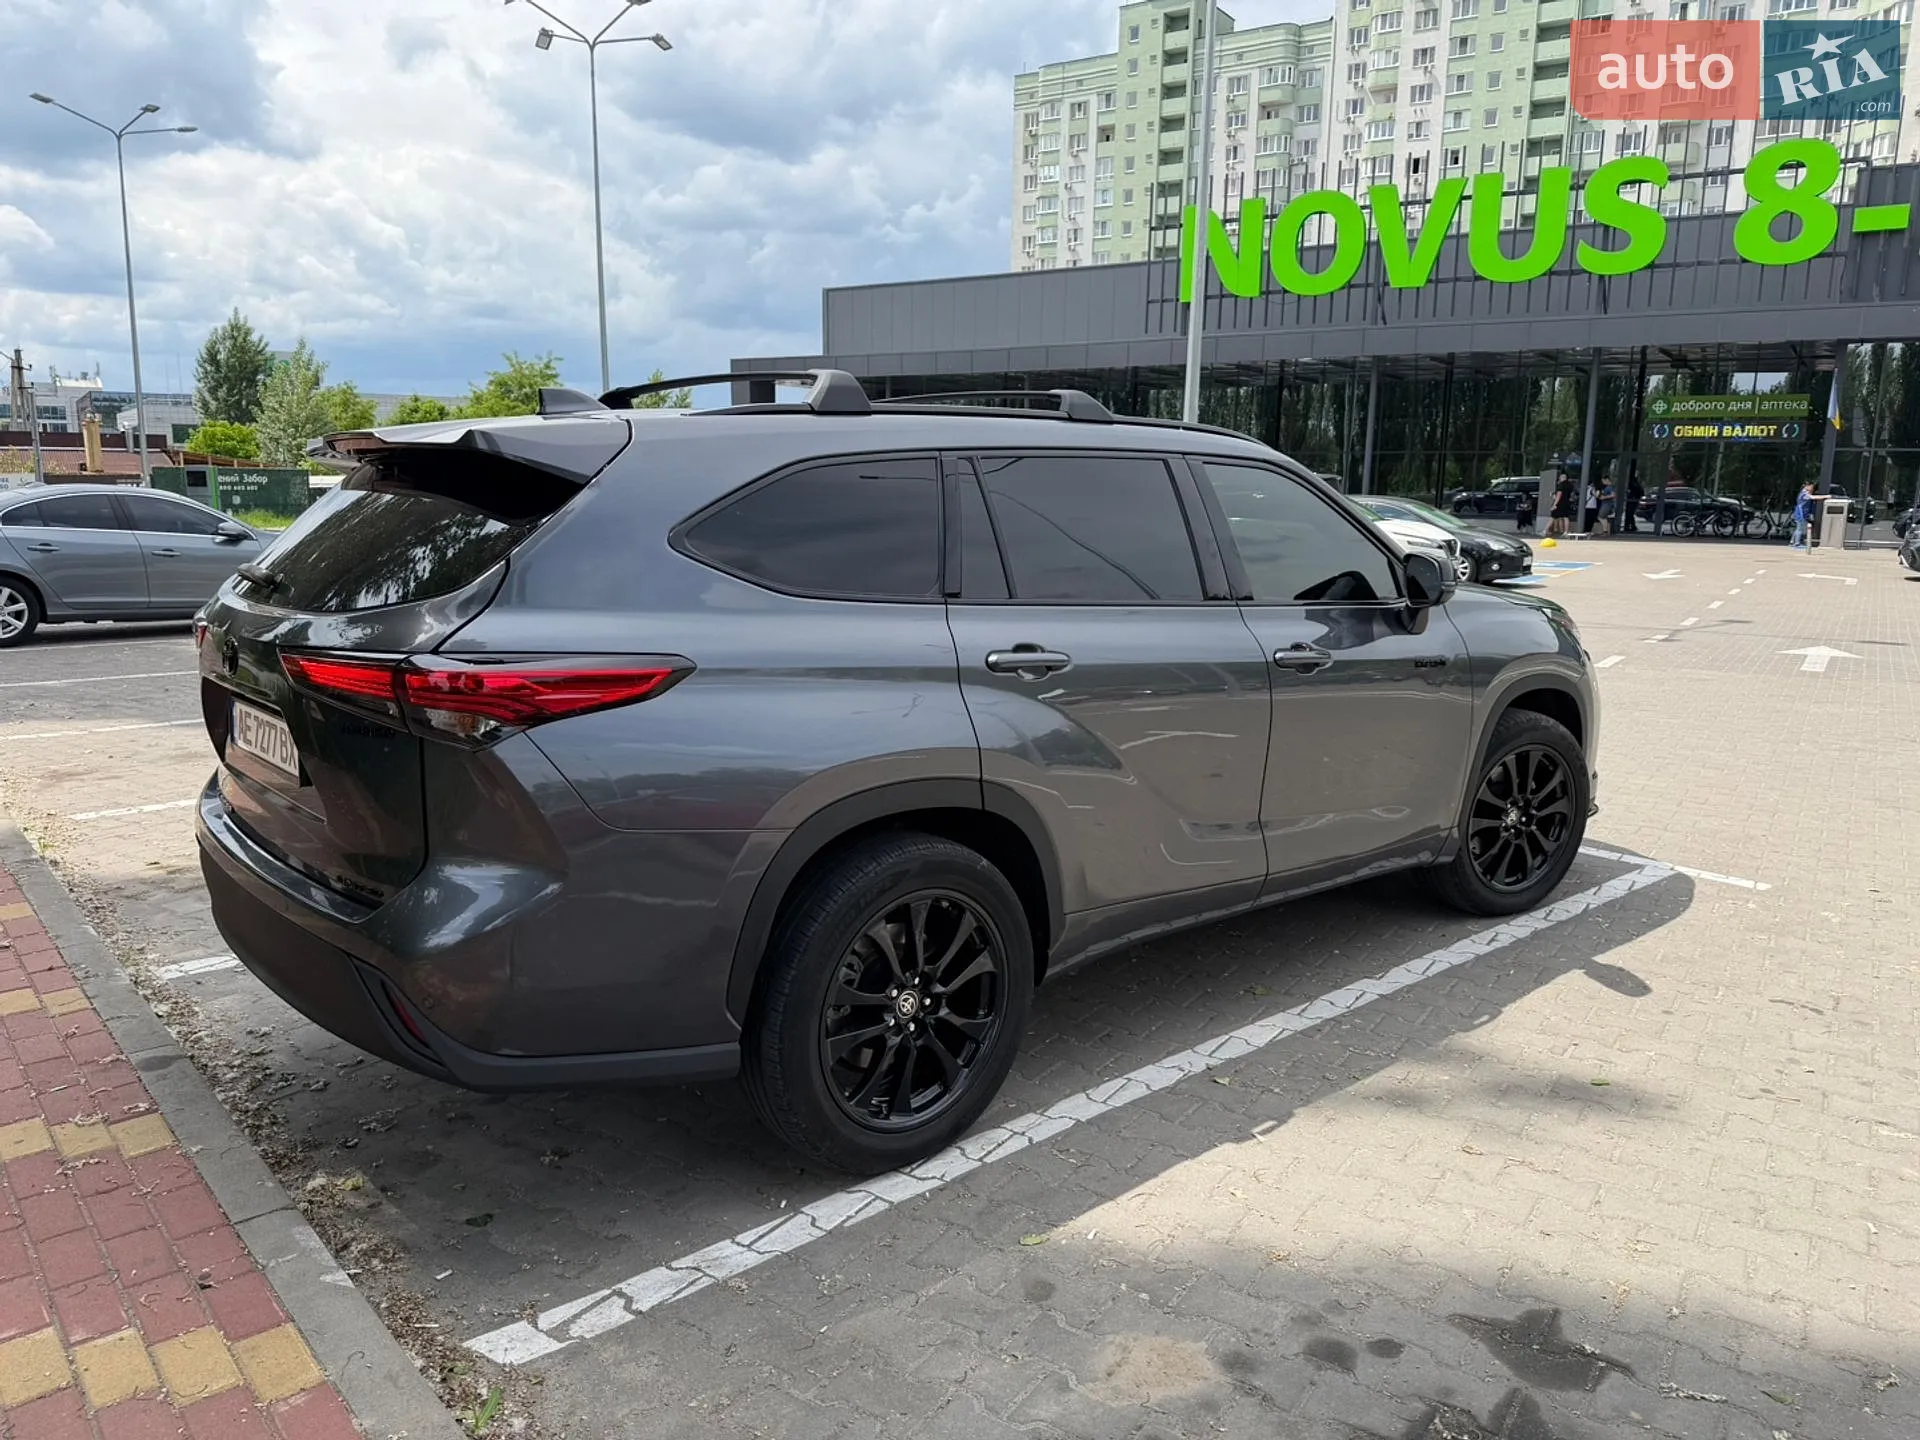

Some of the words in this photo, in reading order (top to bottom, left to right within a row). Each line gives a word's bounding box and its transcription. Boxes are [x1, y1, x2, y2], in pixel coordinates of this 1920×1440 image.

[1180, 155, 1670, 303] NOVUS
[1672, 399, 1725, 412] доброго
[1728, 400, 1752, 412] дня
[1761, 399, 1808, 410] аптека
[1673, 425, 1718, 437] ОБМІН
[1722, 425, 1777, 437] ВАЛЮТ
[243, 473, 268, 485] Забор
[239, 708, 252, 746] AE
[253, 714, 278, 758] 7277
[280, 726, 297, 769] BX
